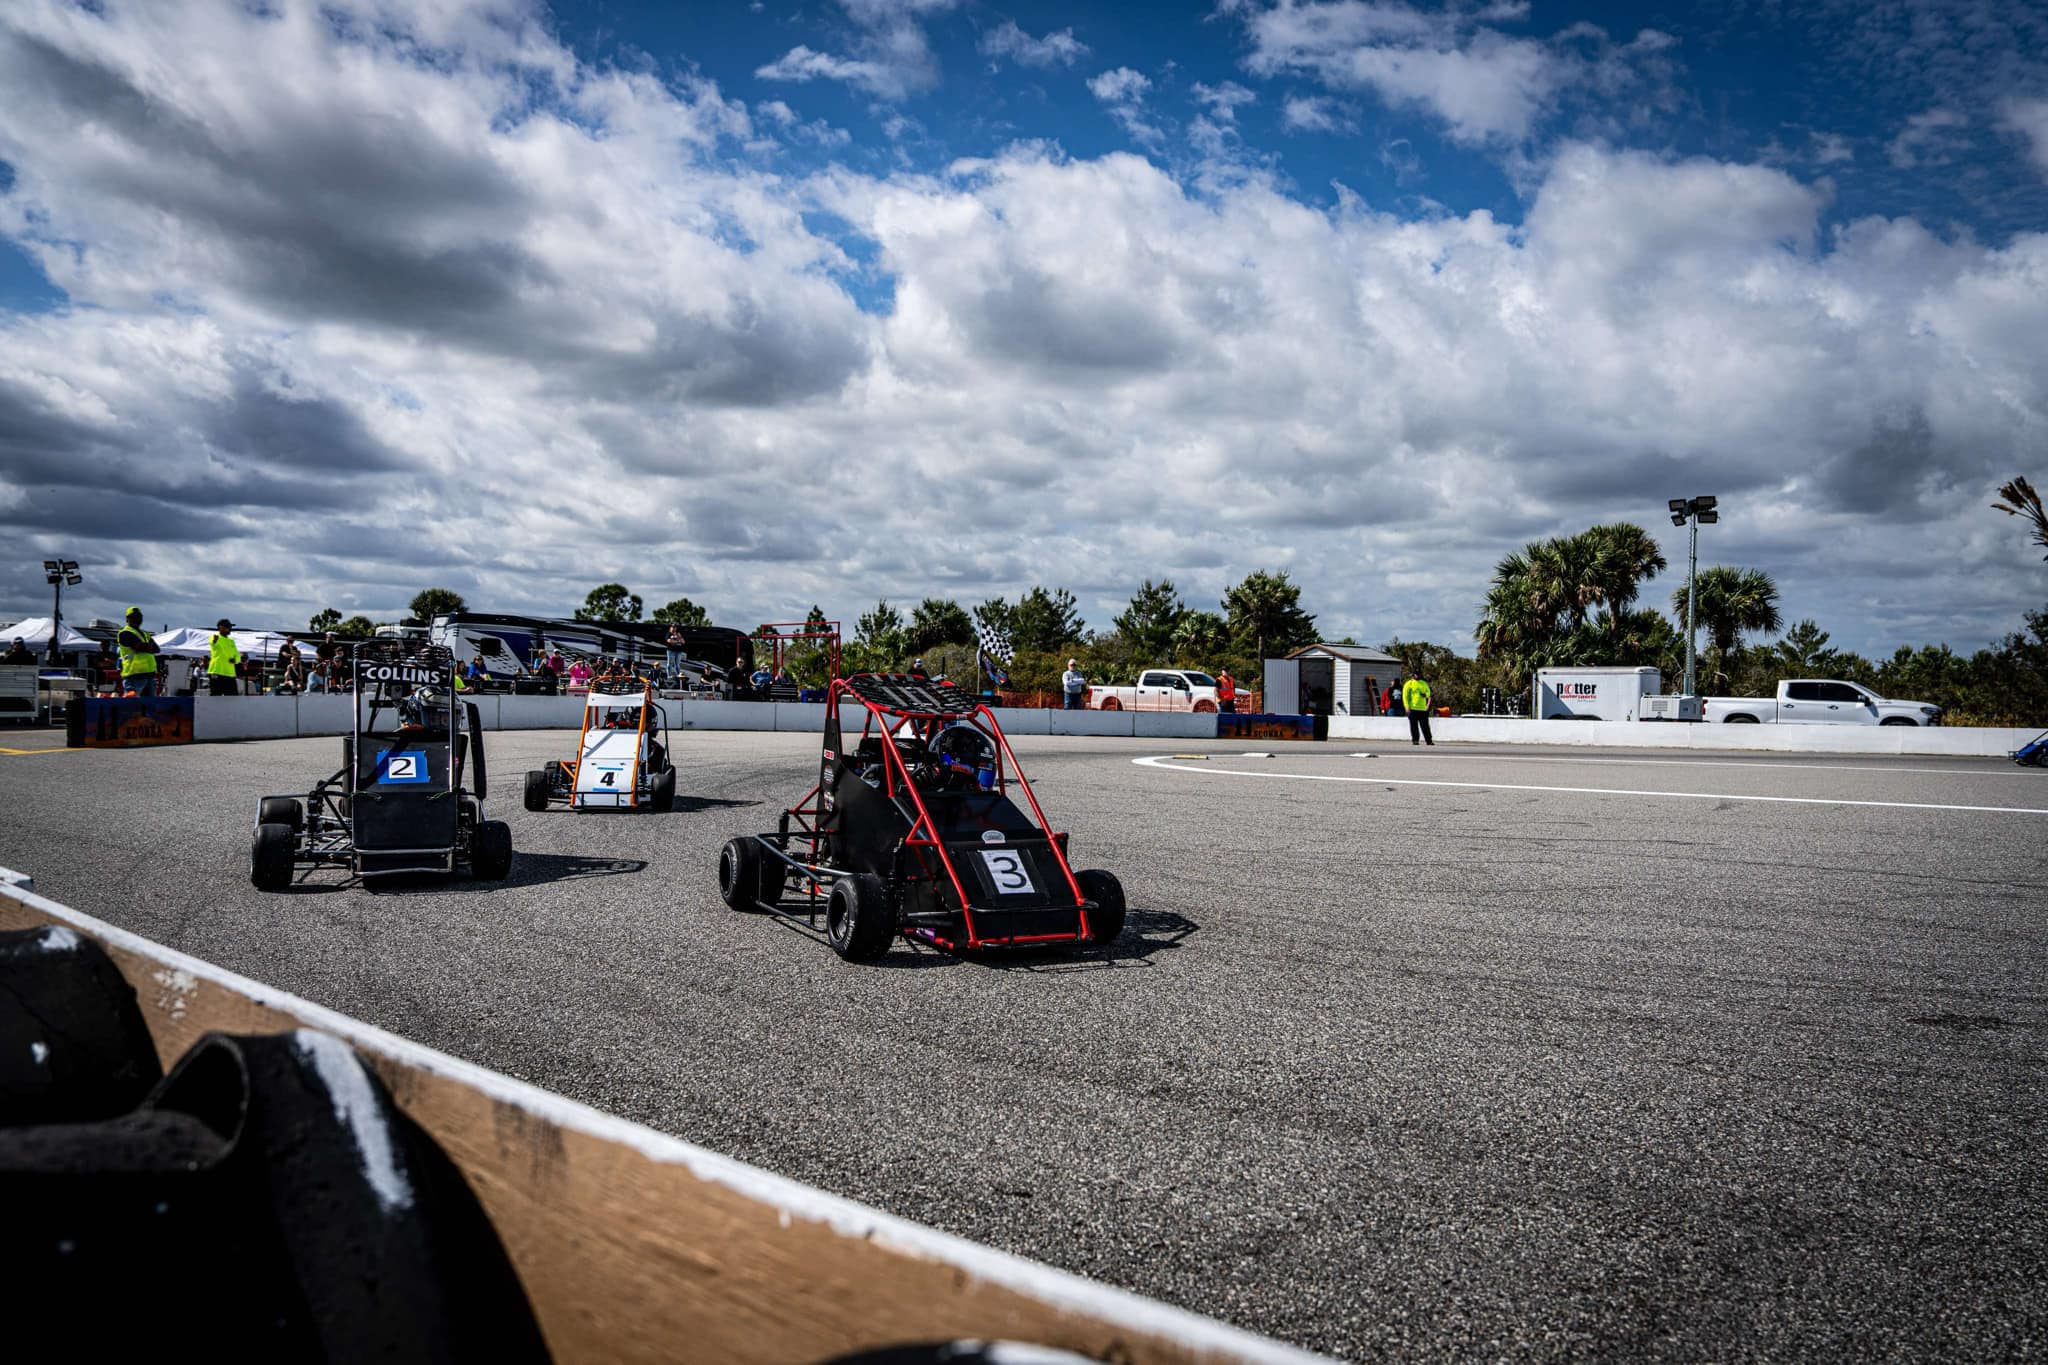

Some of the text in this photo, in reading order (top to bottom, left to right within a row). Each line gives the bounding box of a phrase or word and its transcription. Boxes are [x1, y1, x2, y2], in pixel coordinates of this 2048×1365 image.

[366, 666, 440, 684] COLLINS
[391, 758, 414, 776] 2
[600, 771, 615, 786] 4
[993, 856, 1027, 889] 3
